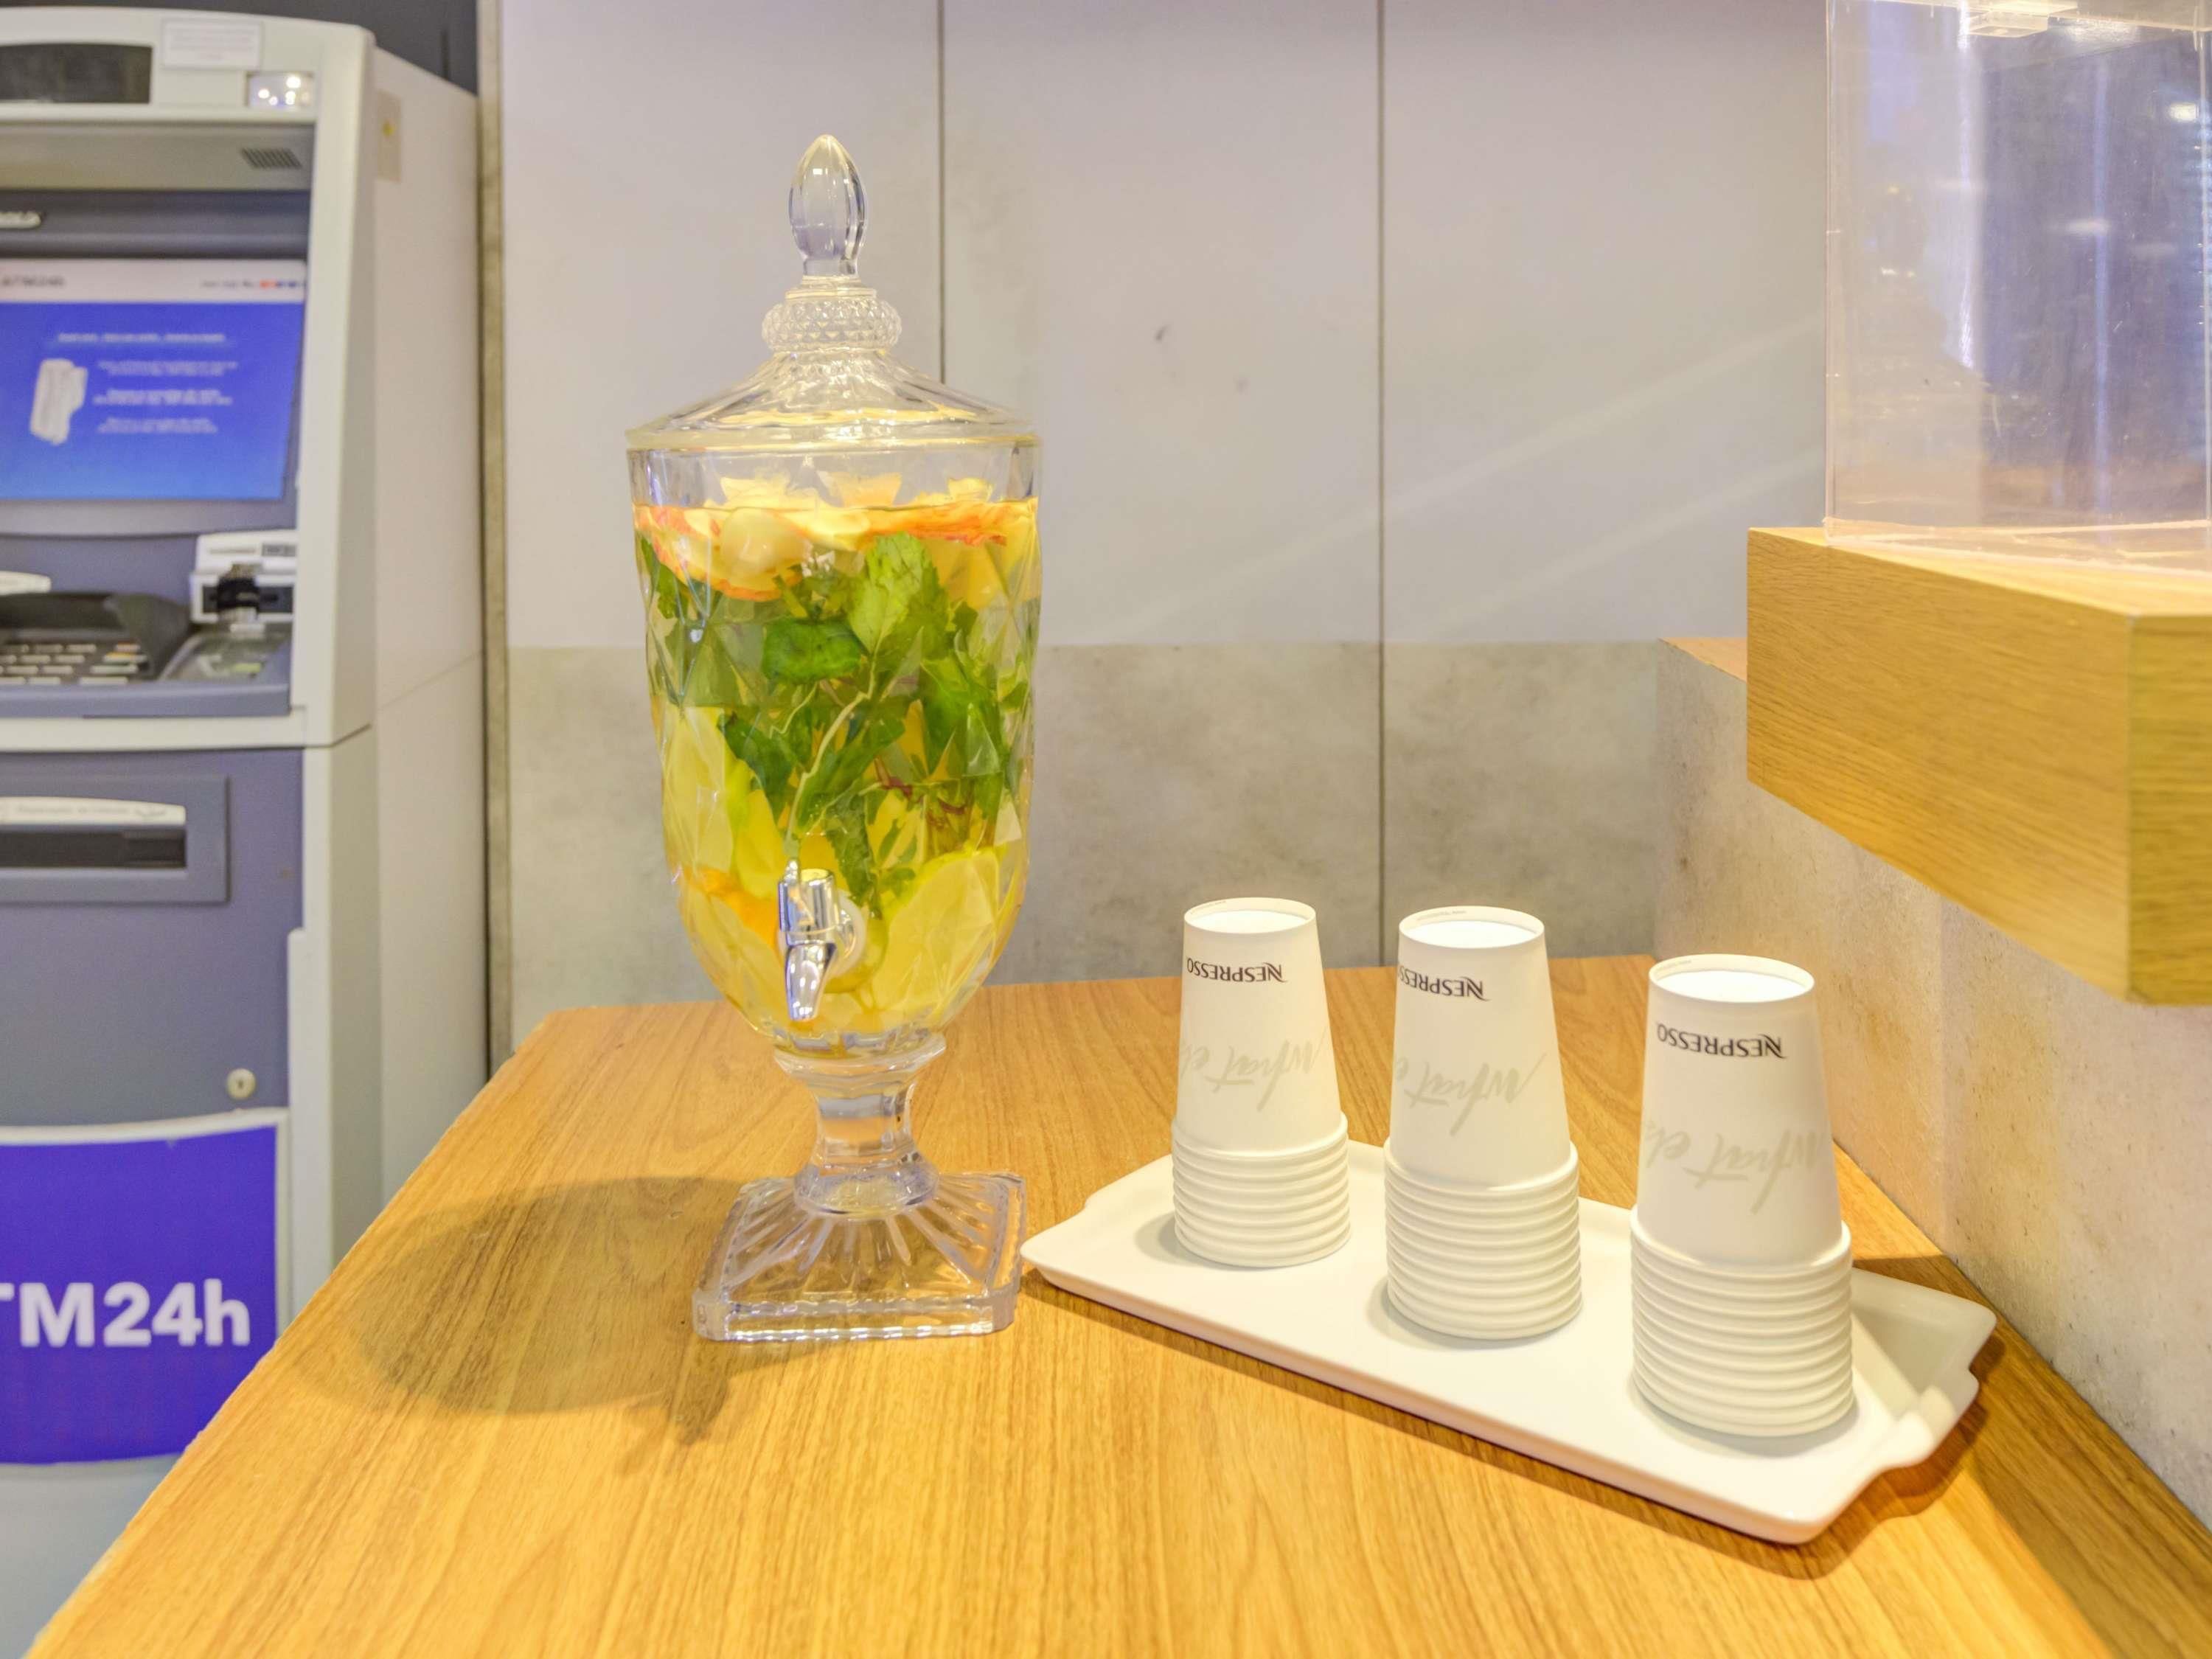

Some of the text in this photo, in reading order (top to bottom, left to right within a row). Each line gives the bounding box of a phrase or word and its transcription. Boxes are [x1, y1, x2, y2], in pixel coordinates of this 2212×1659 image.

[1186, 958, 1288, 984] NESPRESSO
[1399, 965, 1492, 1002] NESPRESS
[1658, 1023, 1787, 1060] NESPRESSO
